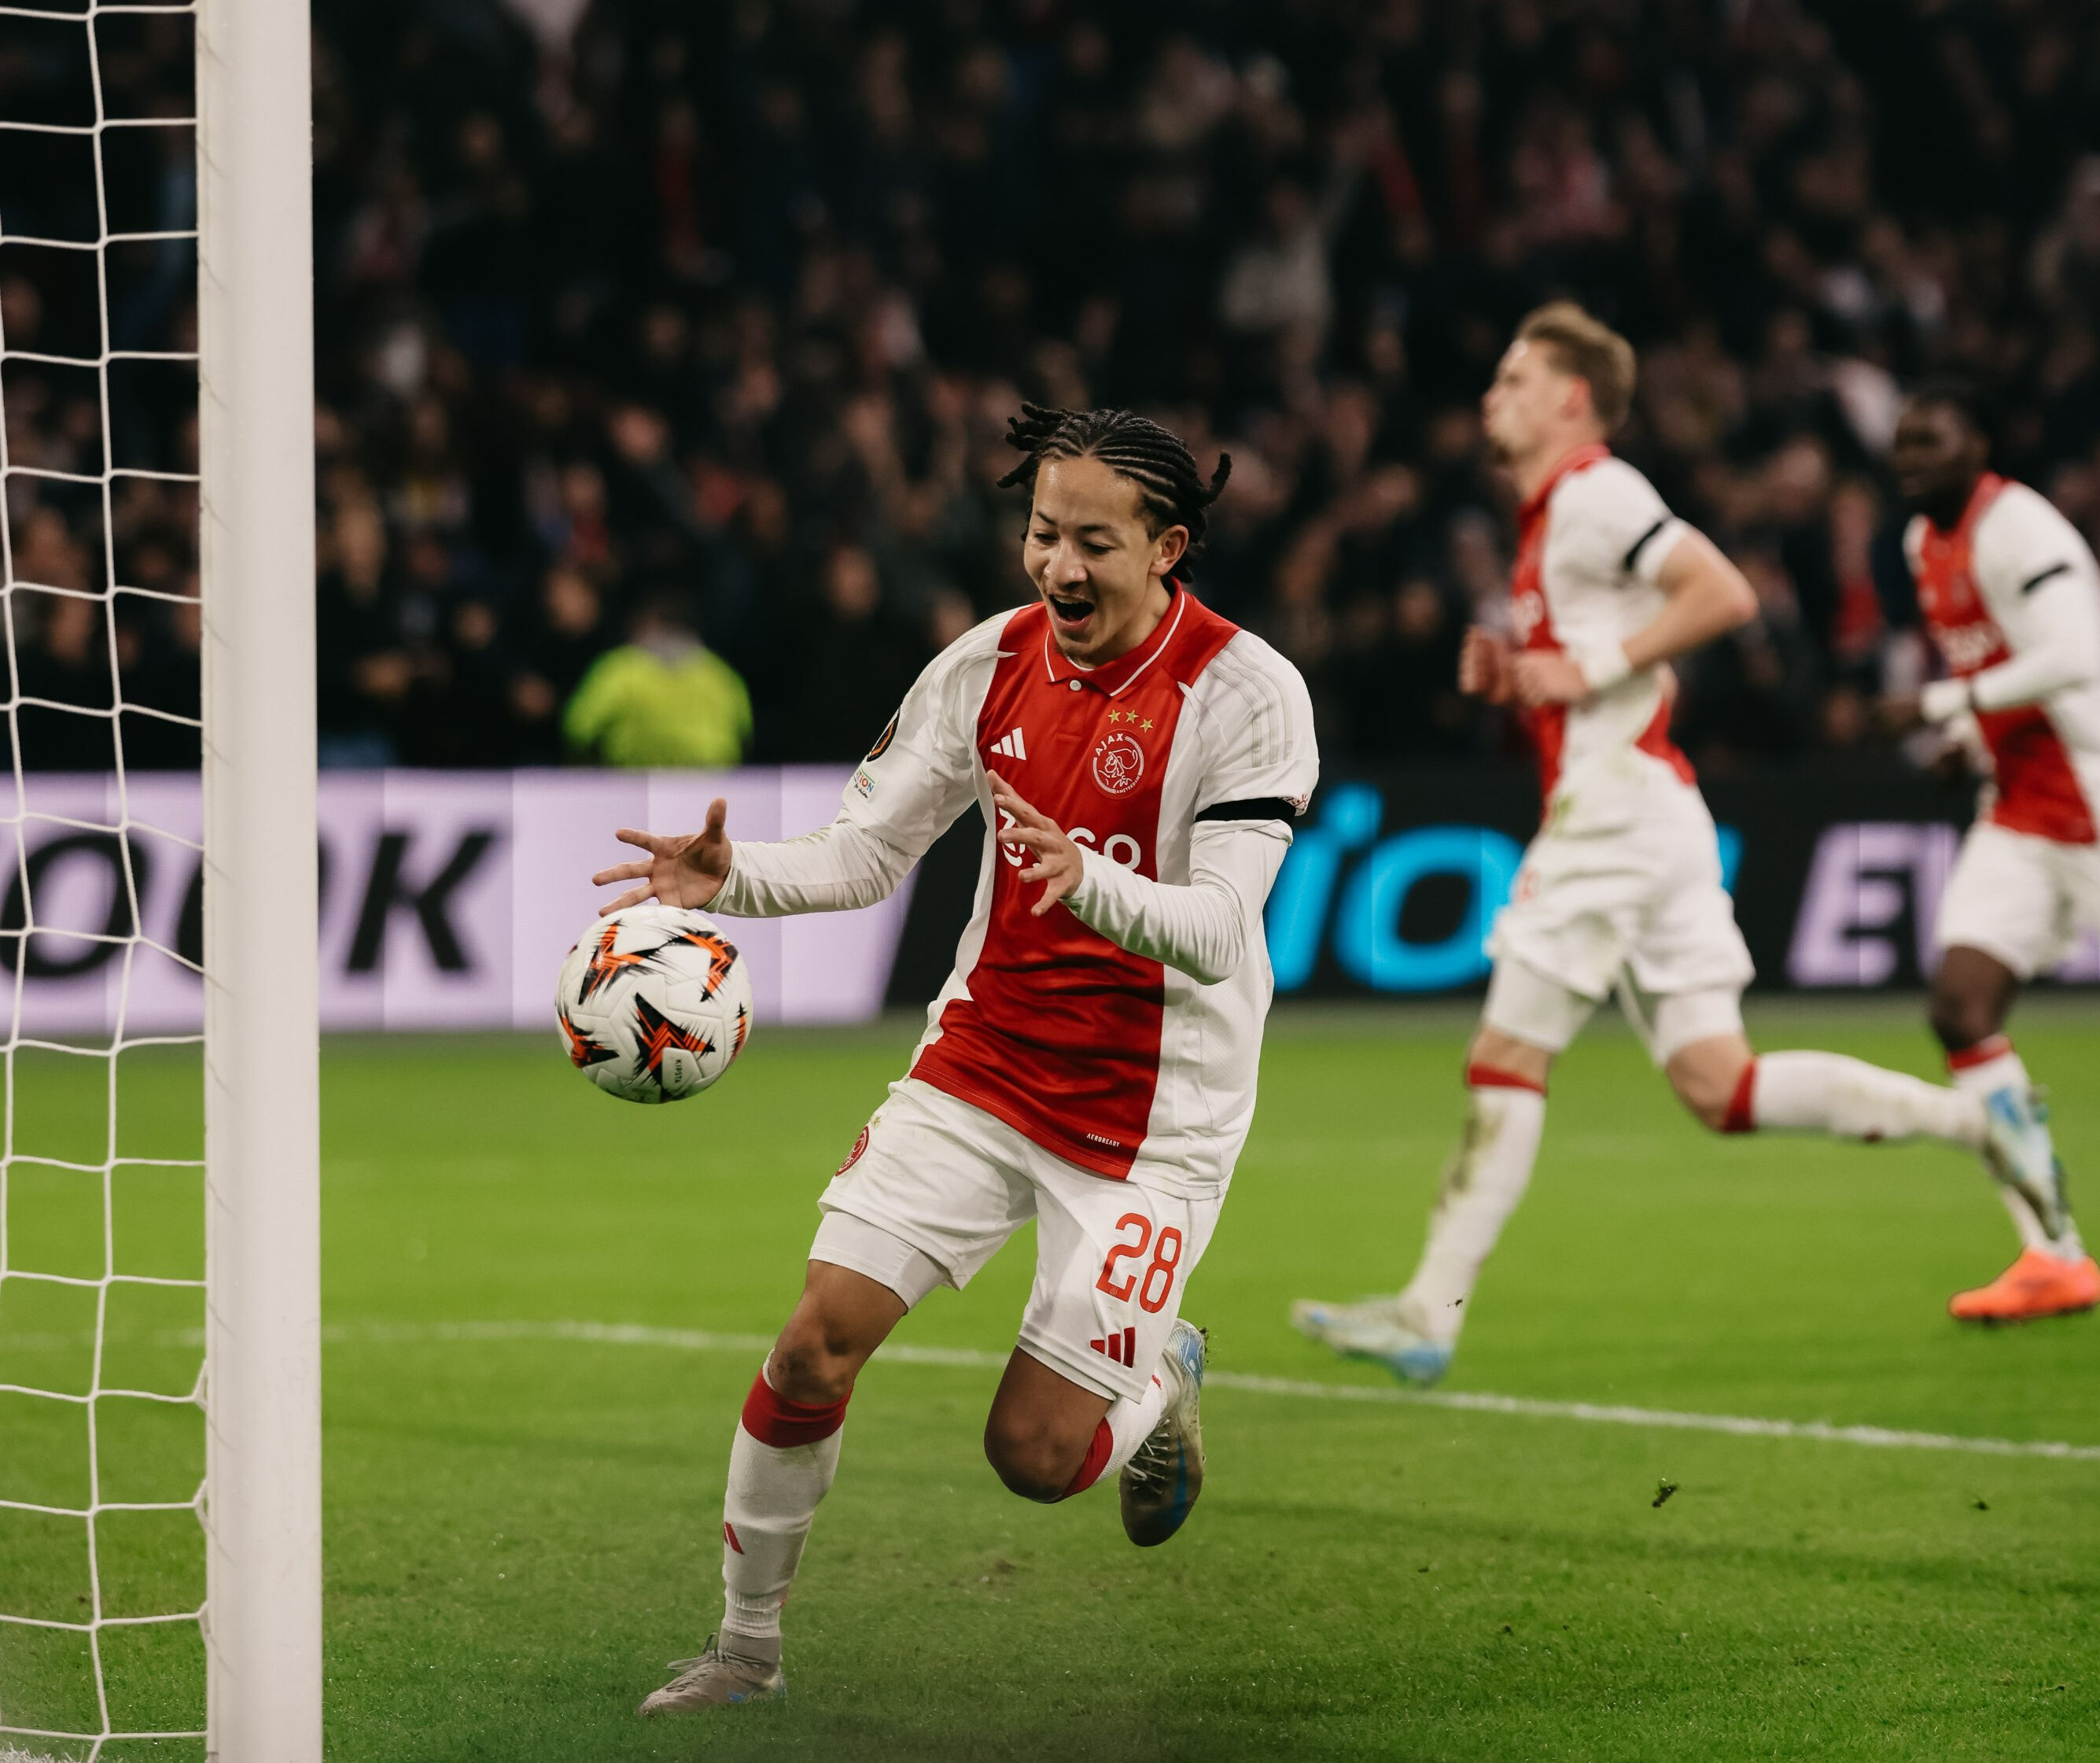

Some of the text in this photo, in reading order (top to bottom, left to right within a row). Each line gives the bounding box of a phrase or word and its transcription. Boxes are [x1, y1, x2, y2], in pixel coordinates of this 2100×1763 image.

[1096, 733, 1123, 756] AJAX
[674, 1059, 683, 1083] KIPSTA
[1086, 1133, 1120, 1147] AEROREADY
[1096, 1212, 1182, 1313] 28
